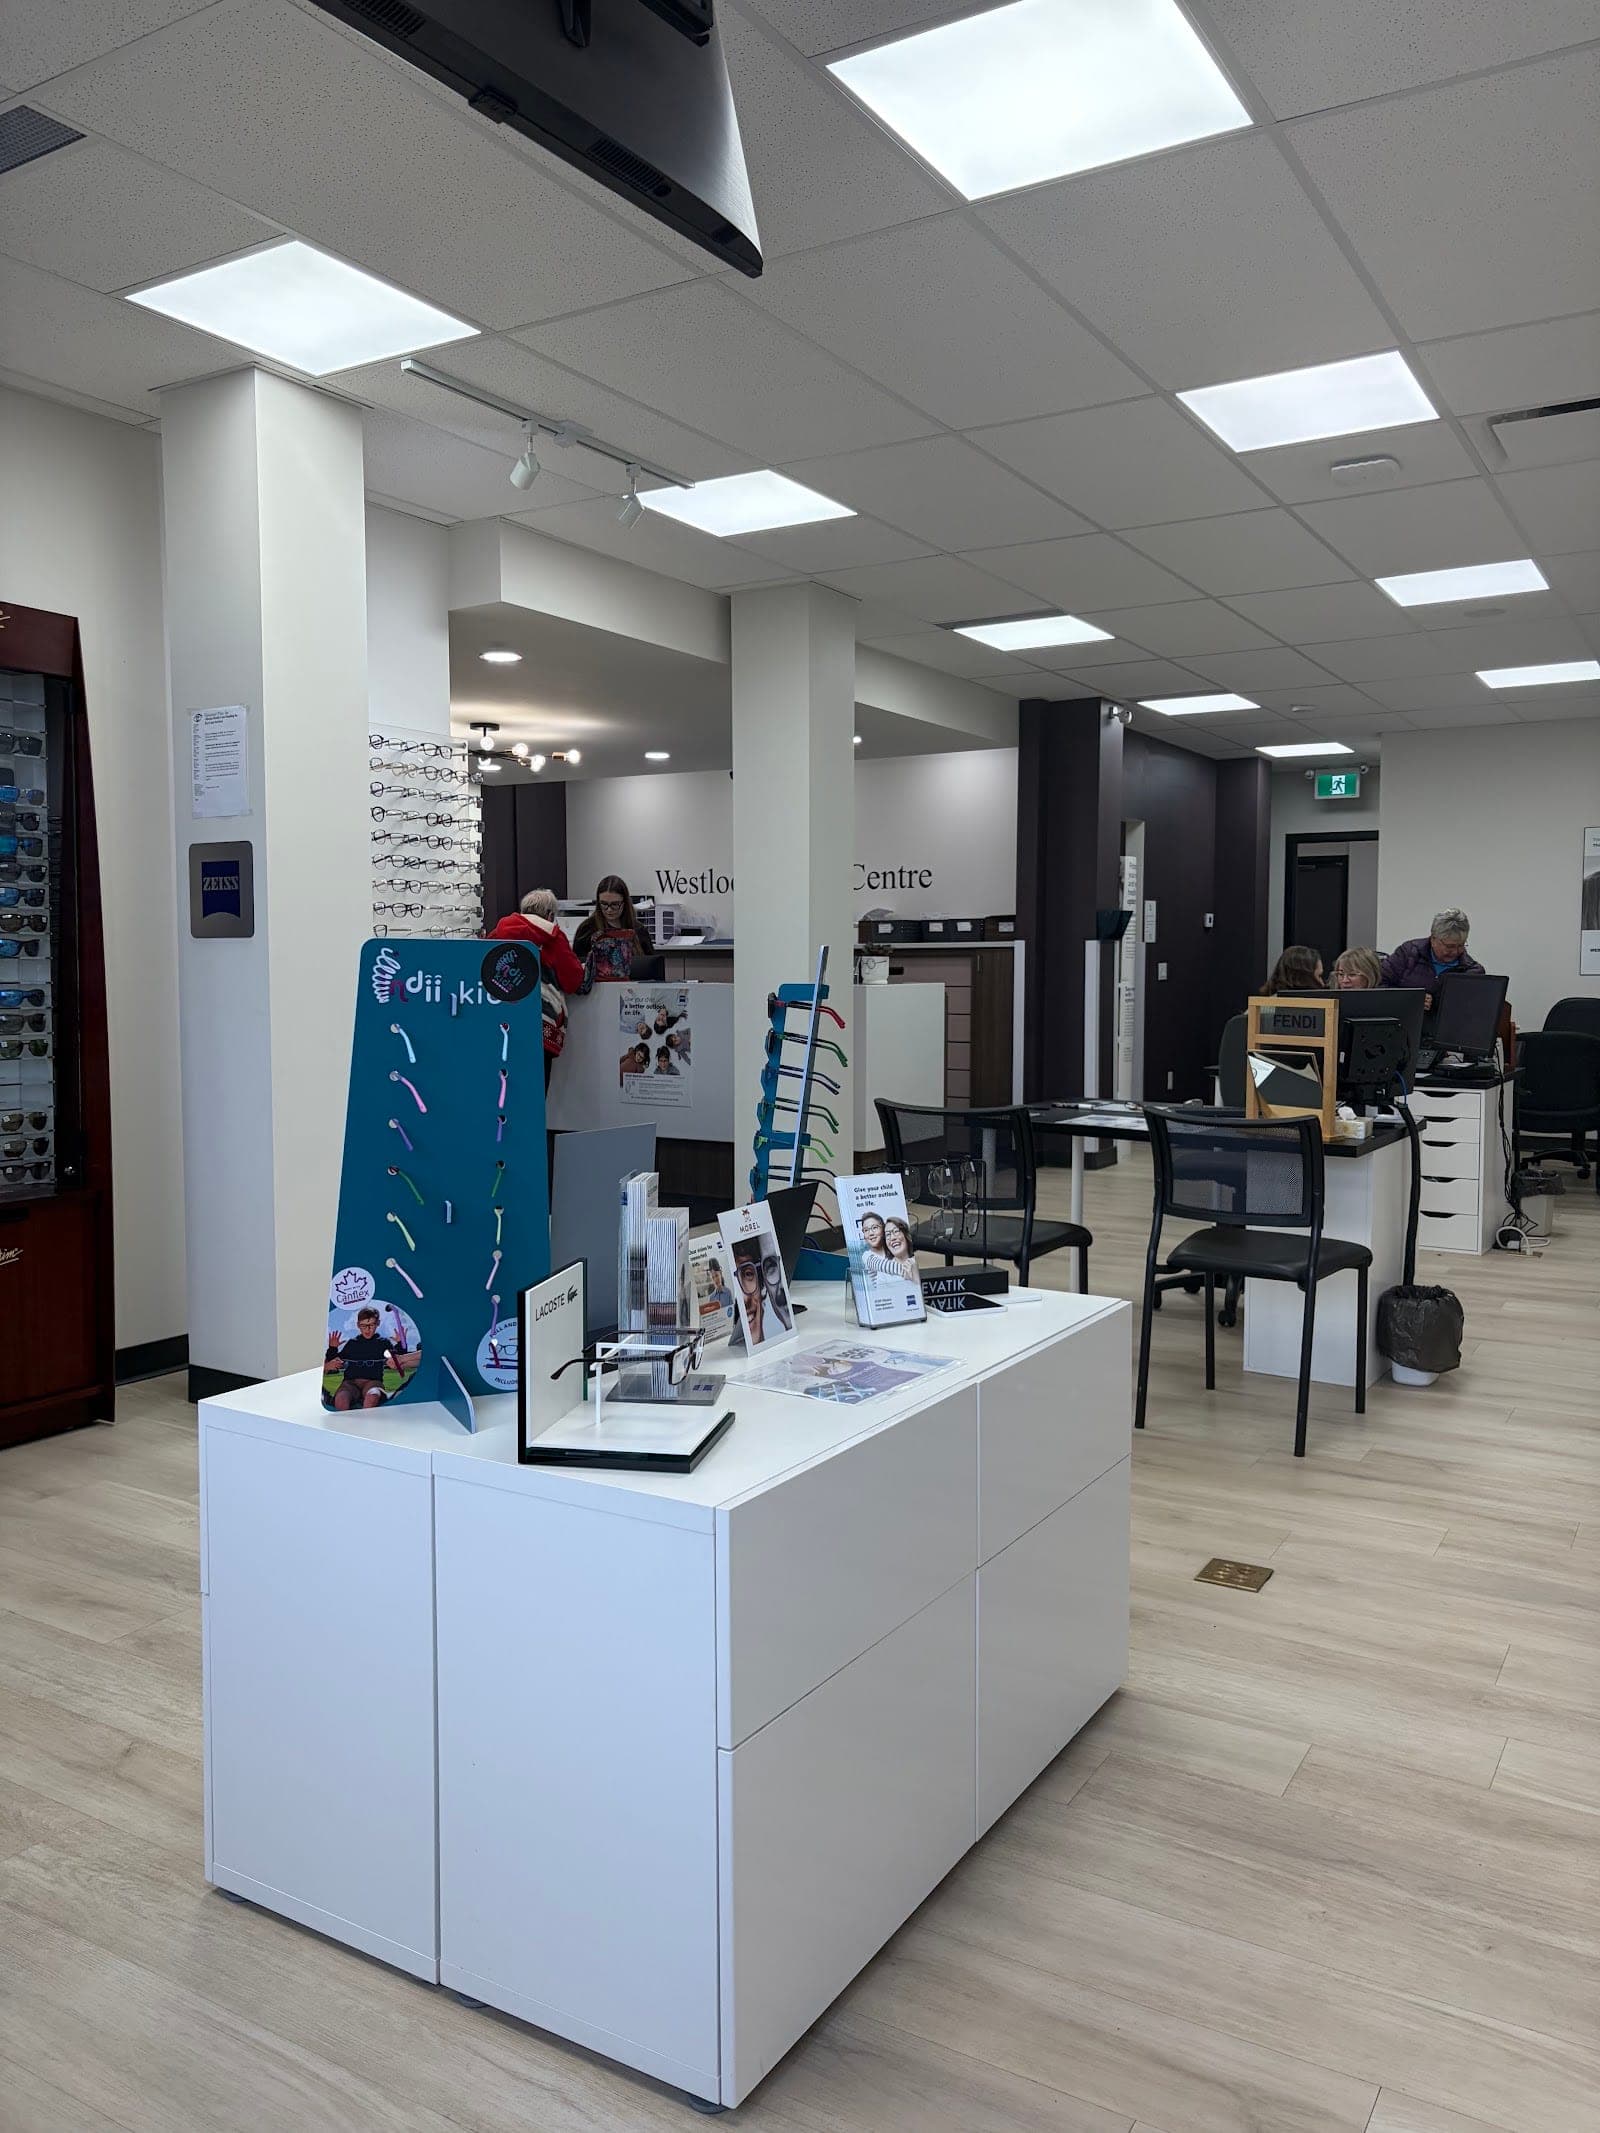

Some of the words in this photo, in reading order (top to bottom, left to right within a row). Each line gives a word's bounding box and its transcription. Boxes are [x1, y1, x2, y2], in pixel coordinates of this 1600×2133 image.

[202, 876, 239, 891] ZEISS
[459, 980, 501, 1005] ki
[1273, 1014, 1317, 1029] FENDI
[740, 1222, 761, 1232] MOREL
[921, 1278, 966, 1294] EVATIK
[535, 1293, 566, 1322] LACOSTE
